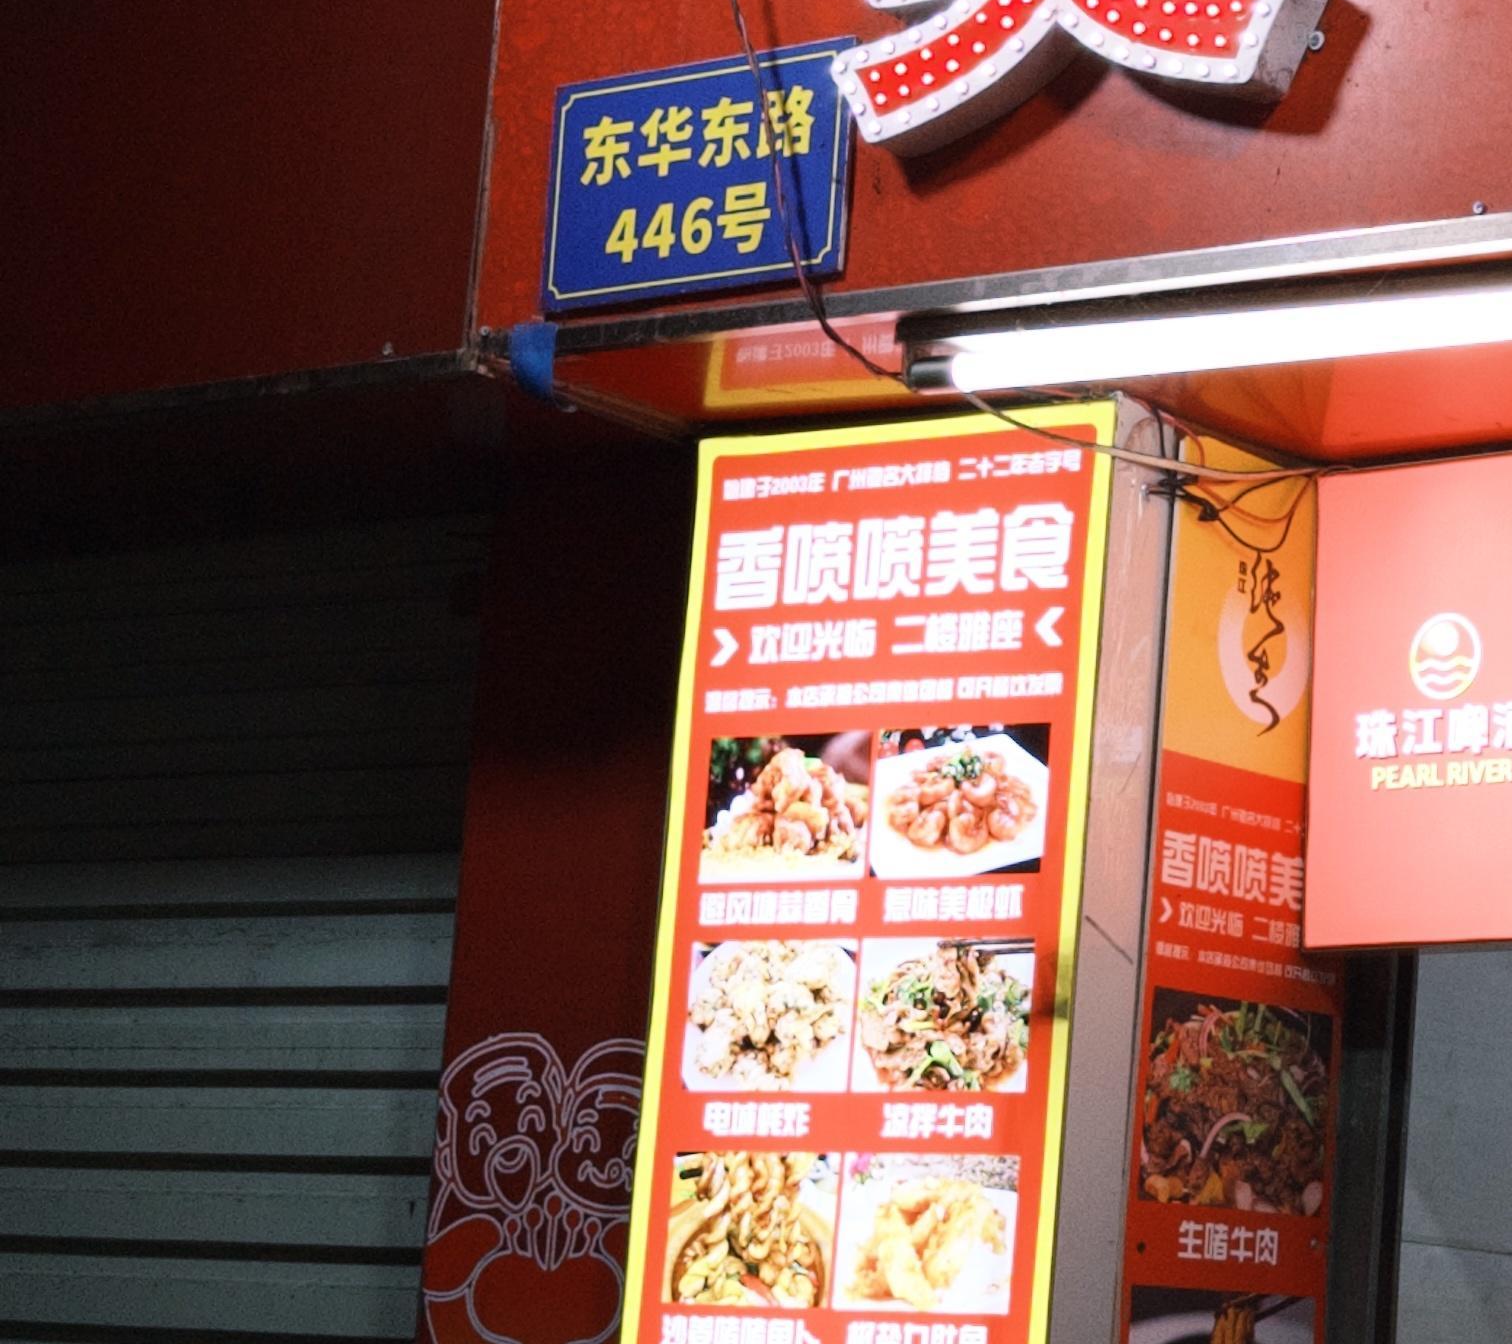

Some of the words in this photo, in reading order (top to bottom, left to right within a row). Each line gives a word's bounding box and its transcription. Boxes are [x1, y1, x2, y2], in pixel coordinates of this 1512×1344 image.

[580, 86, 816, 186] 东华东路
[605, 183, 772, 265] 446号
[715, 503, 1074, 610] 香喷喷美食
[749, 619, 876, 664] 欢迎光临
[892, 611, 1024, 654] 二楼雅座
[1371, 762, 1444, 790] PEARL
[1177, 1219, 1279, 1266] 生啫牛肉
